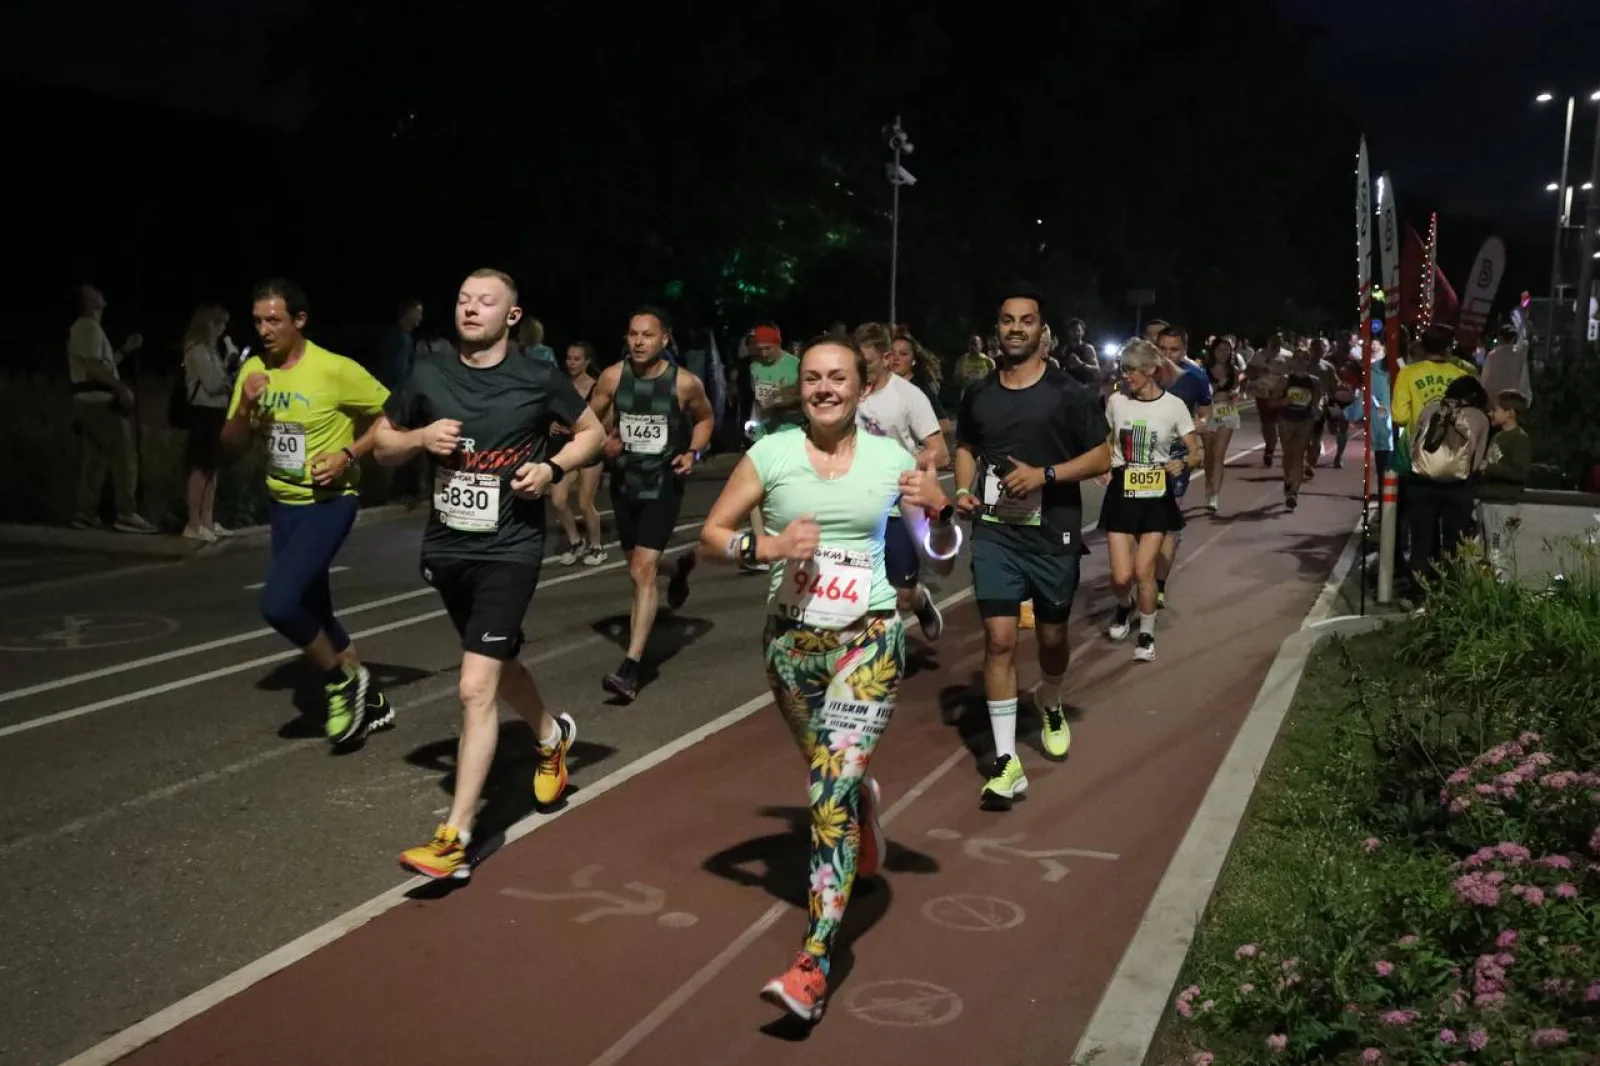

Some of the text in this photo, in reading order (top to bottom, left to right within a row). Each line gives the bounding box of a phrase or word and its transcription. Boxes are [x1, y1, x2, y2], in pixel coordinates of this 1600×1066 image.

[625, 424, 661, 439] 1463
[1129, 472, 1161, 485] 8057
[441, 486, 489, 511] 5830
[794, 570, 859, 603] 9464
